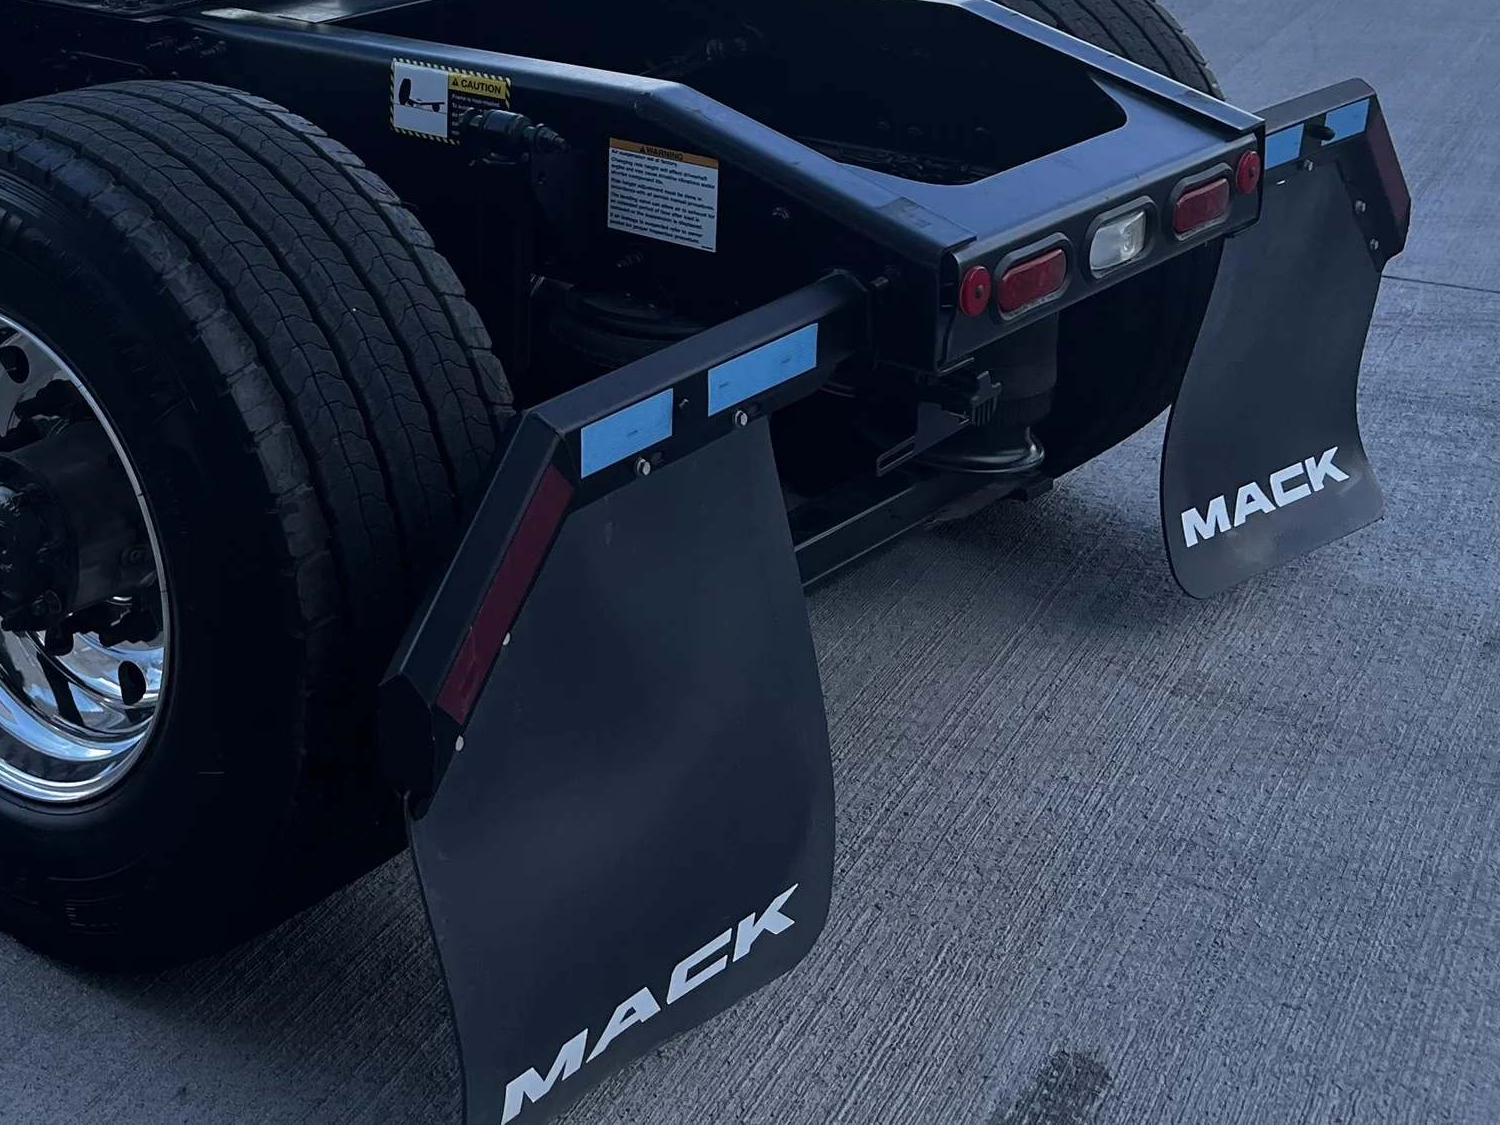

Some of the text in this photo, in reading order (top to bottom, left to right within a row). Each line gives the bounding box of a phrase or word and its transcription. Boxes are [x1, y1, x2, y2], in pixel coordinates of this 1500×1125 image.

[461, 79, 501, 95] CAUTION
[646, 147, 684, 161] WARNING
[1181, 445, 1350, 548] MACK
[500, 883, 799, 1125] MACK
